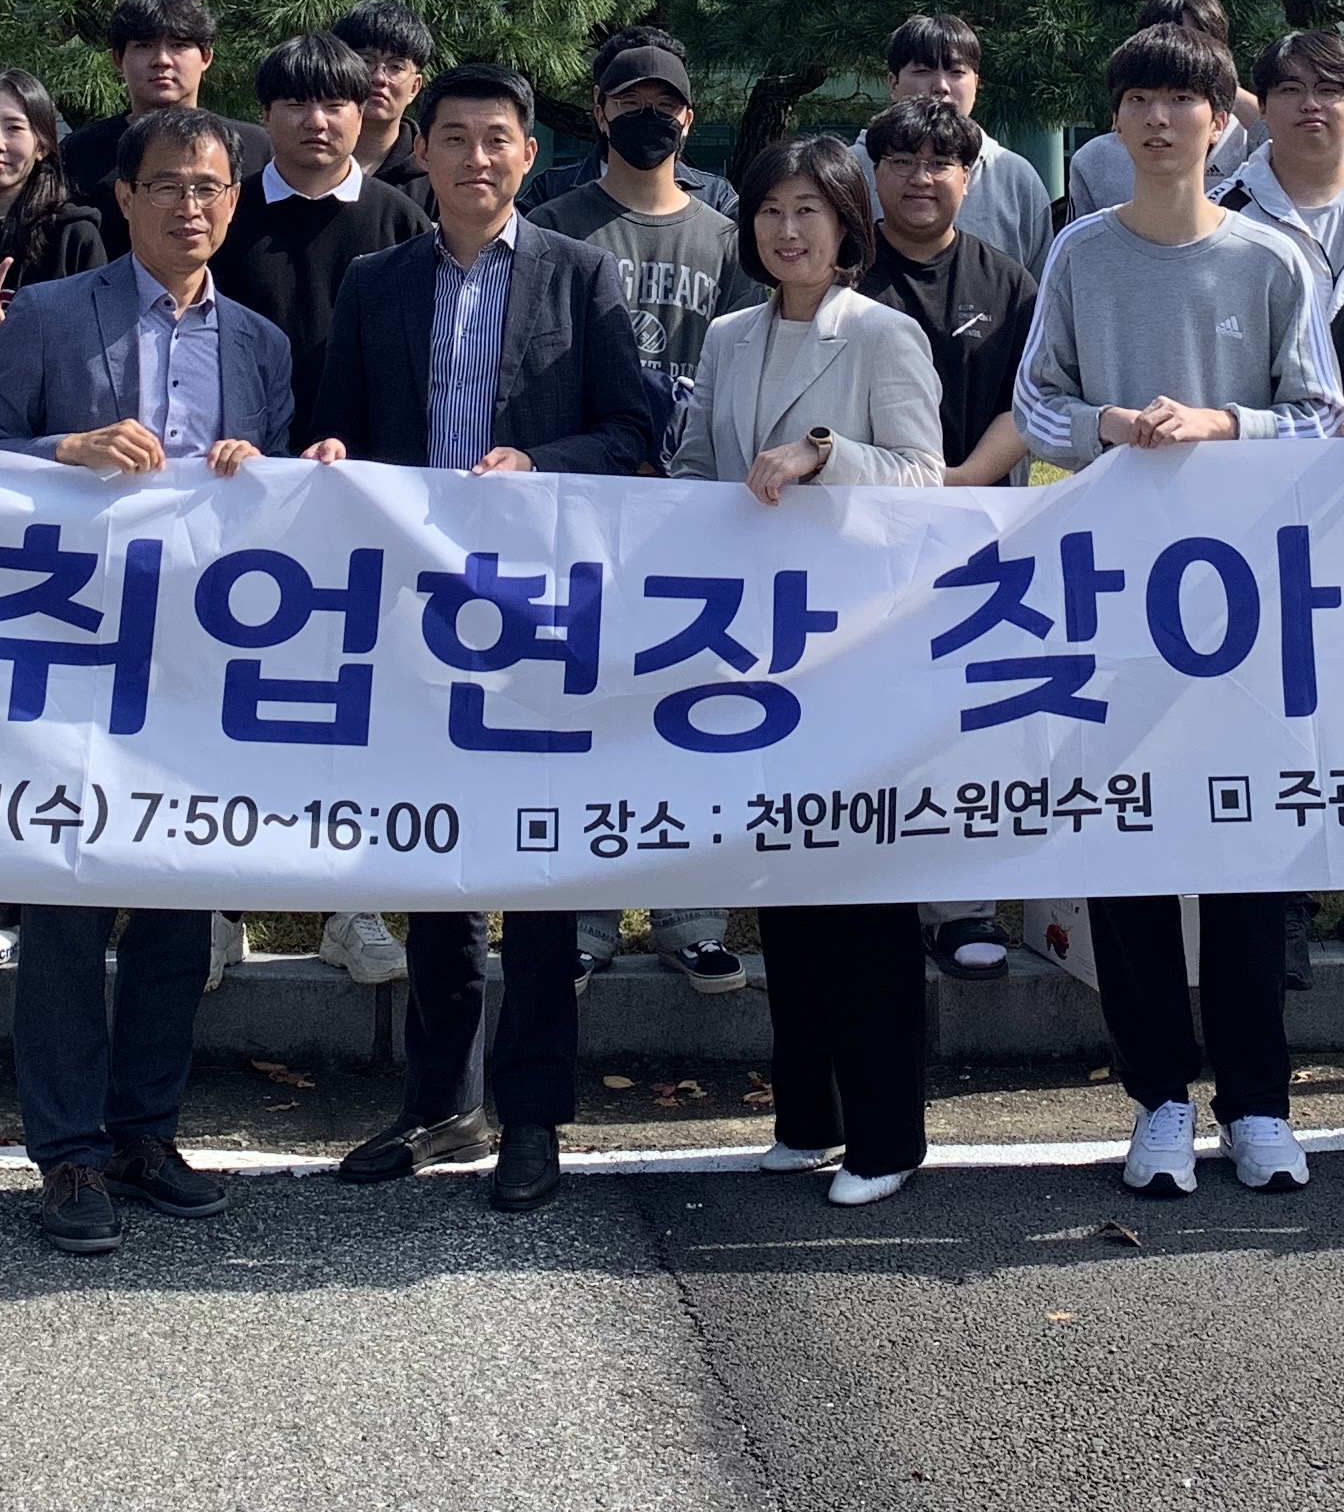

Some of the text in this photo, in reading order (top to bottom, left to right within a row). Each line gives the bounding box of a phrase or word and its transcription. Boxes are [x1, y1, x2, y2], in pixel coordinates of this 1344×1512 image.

[131, 790, 461, 855] 7:50~16:00
[583, 799, 691, 859] 장소
[745, 770, 1155, 854] 천안에스원연수원
